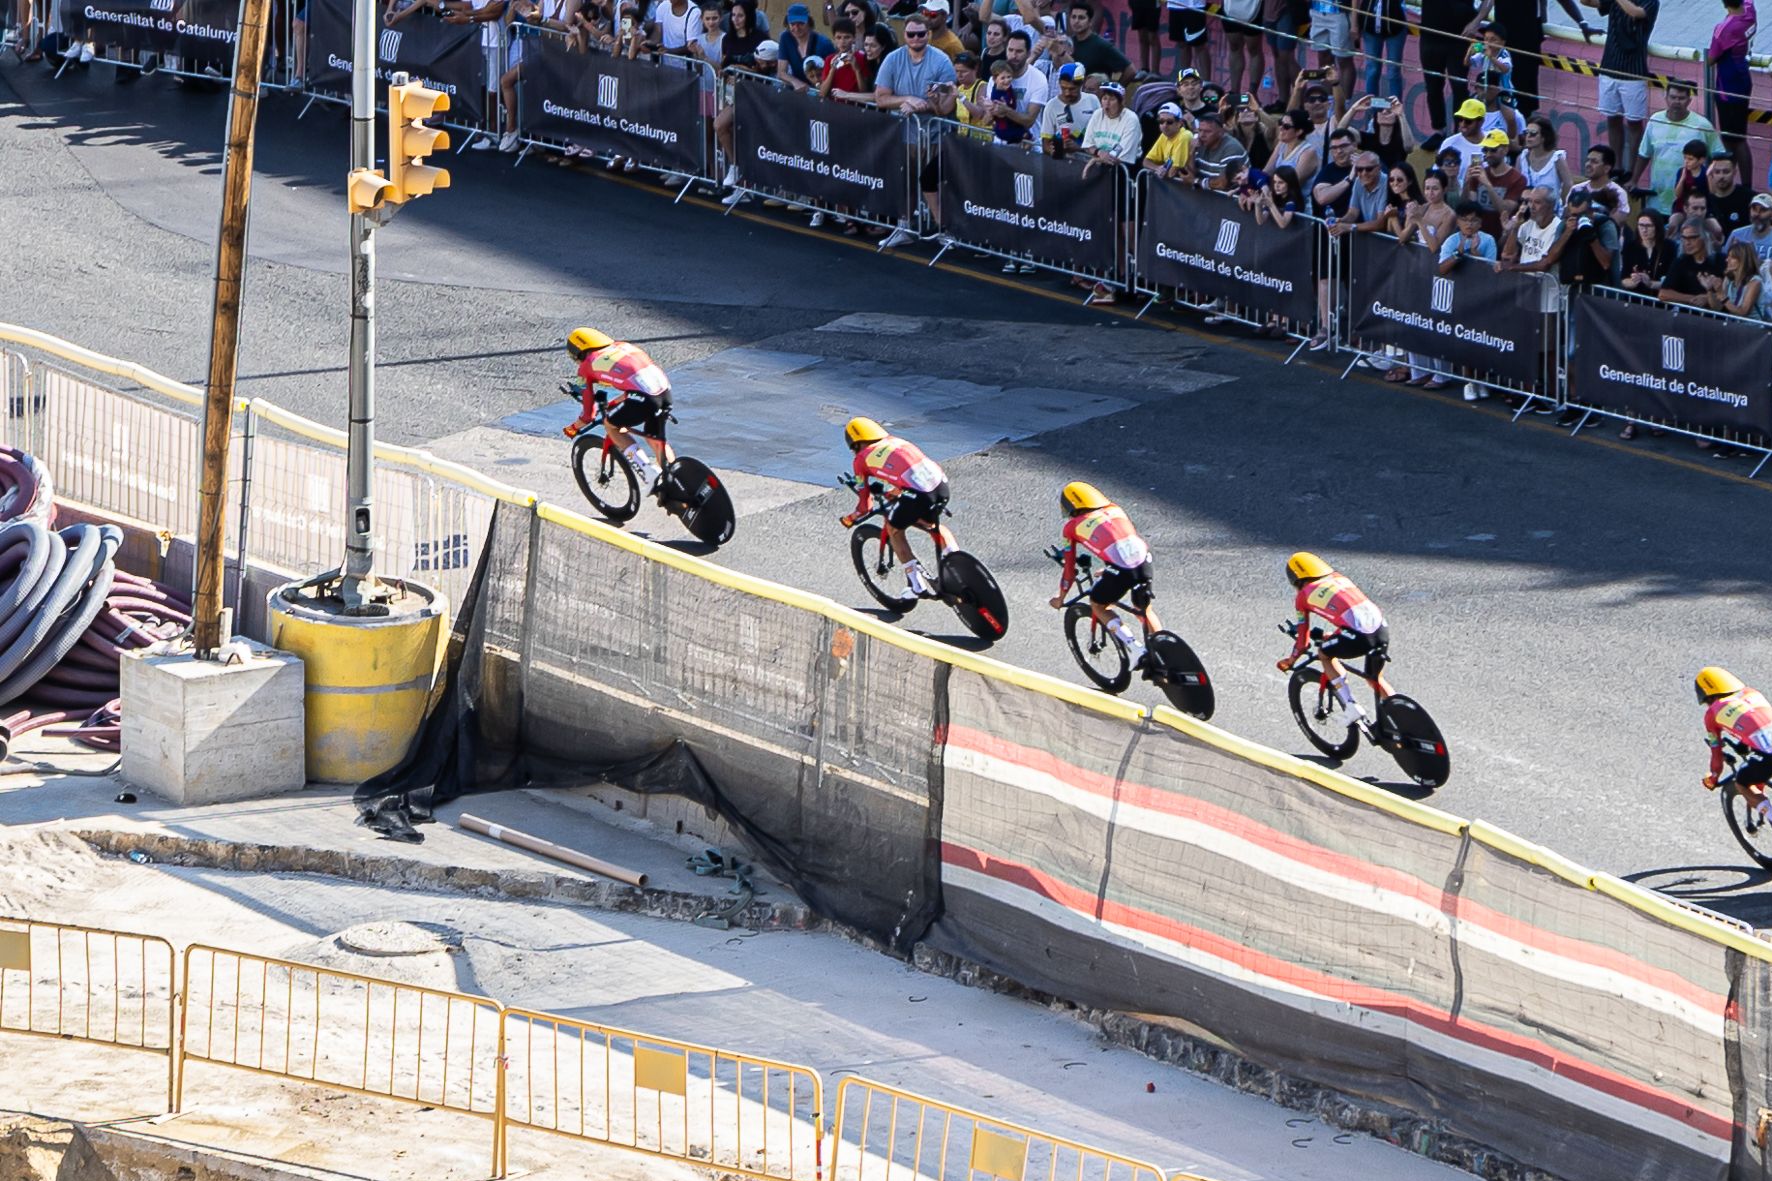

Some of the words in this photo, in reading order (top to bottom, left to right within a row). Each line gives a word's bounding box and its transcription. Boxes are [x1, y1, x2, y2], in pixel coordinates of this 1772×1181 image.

[85, 5, 155, 28] Generalitat
[157, 18, 173, 31] de
[543, 99, 601, 125] Generalitat
[603, 112, 618, 128] de
[619, 118, 677, 144] Catalunya
[757, 146, 814, 172] Generalitat
[816, 159, 830, 175] de
[832, 164, 884, 190] Catalunya
[964, 200, 1019, 226] Generalitat
[1021, 213, 1036, 228] de
[1038, 216, 1092, 241] Catalunya
[1156, 242, 1216, 272] Generalitat
[1217, 259, 1232, 276] de
[1234, 263, 1294, 293] Catalunya
[1372, 301, 1434, 332] Generalitat
[1436, 317, 1452, 336] de
[1454, 323, 1515, 353] Catalunya
[1599, 364, 1667, 391] Generalitat
[1669, 378, 1685, 394] de
[1687, 380, 1749, 407] Catalunya
